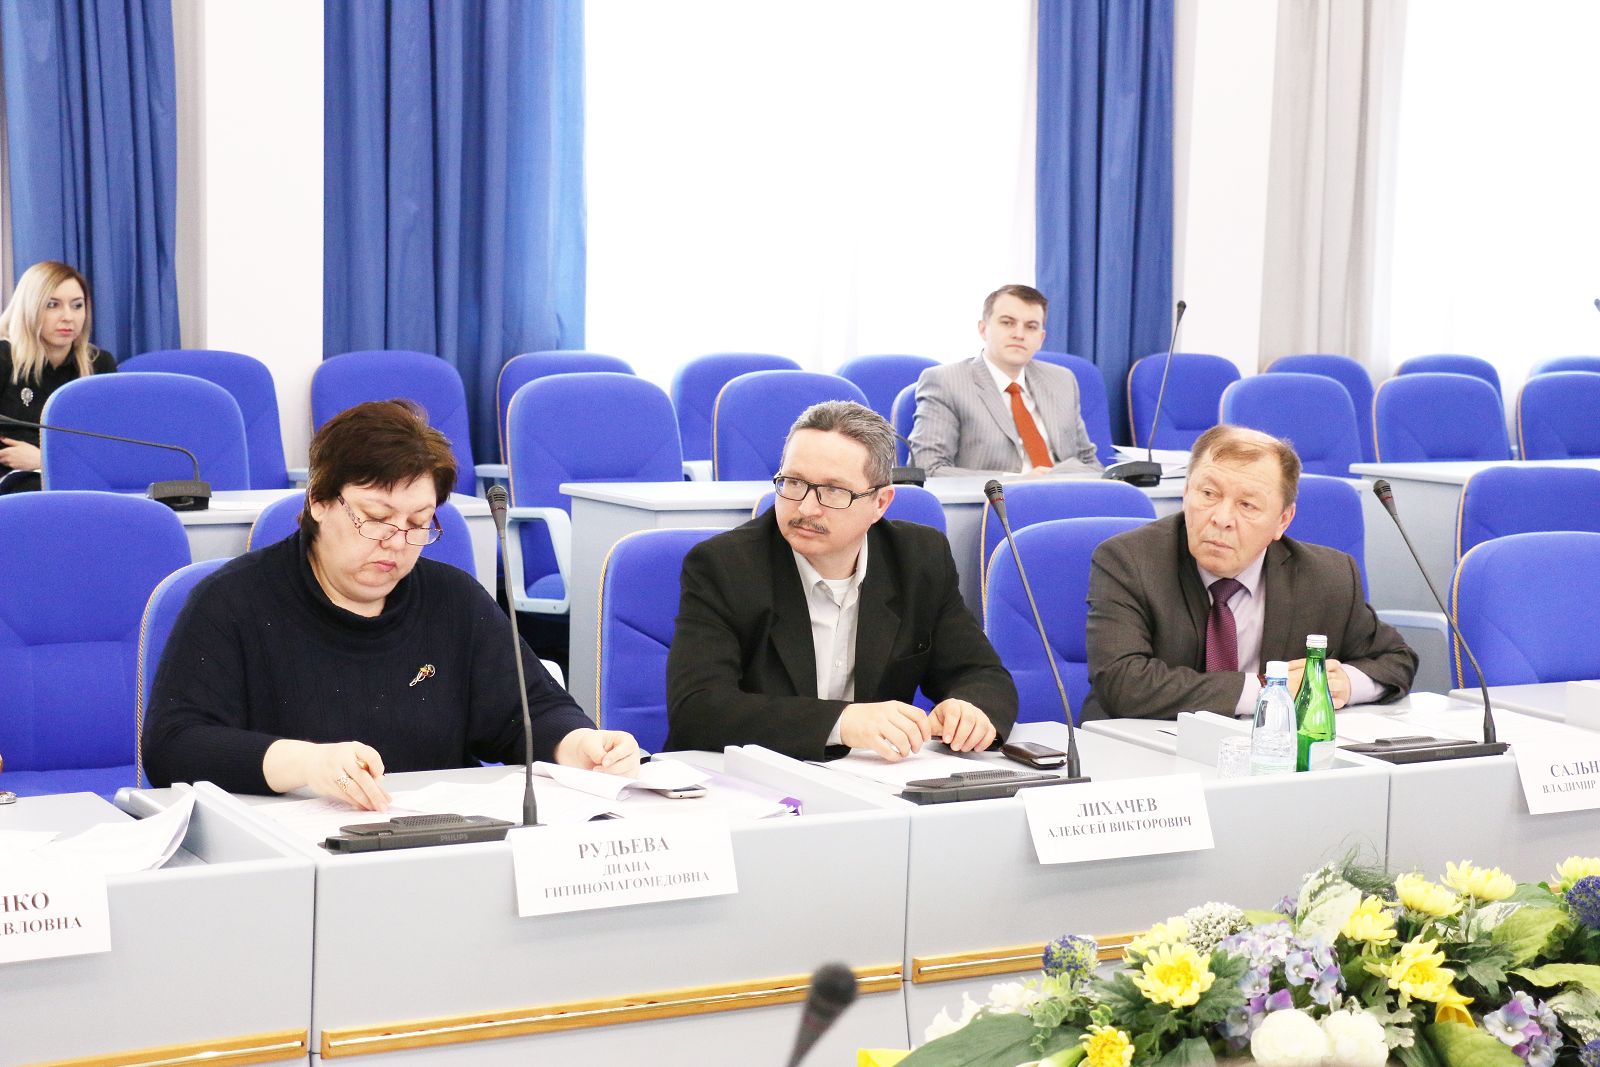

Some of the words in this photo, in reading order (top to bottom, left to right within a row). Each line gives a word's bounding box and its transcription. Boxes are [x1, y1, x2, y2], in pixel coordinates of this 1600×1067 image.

[1542, 779, 1596, 794] ВЛАДИМИР
[1076, 796, 1158, 818] ЛИХАЧЕВ
[1047, 820, 1106, 838] АЛЕКСЕЙ
[1109, 815, 1192, 833] ВИКТОРОВИЧ
[578, 835, 669, 859] РУДЬЕВА
[602, 860, 651, 876] ДИАНА
[544, 870, 710, 899] ГИТИНОМАГОМЕДОВНА
[0, 916, 82, 936] ВЛОВНА
